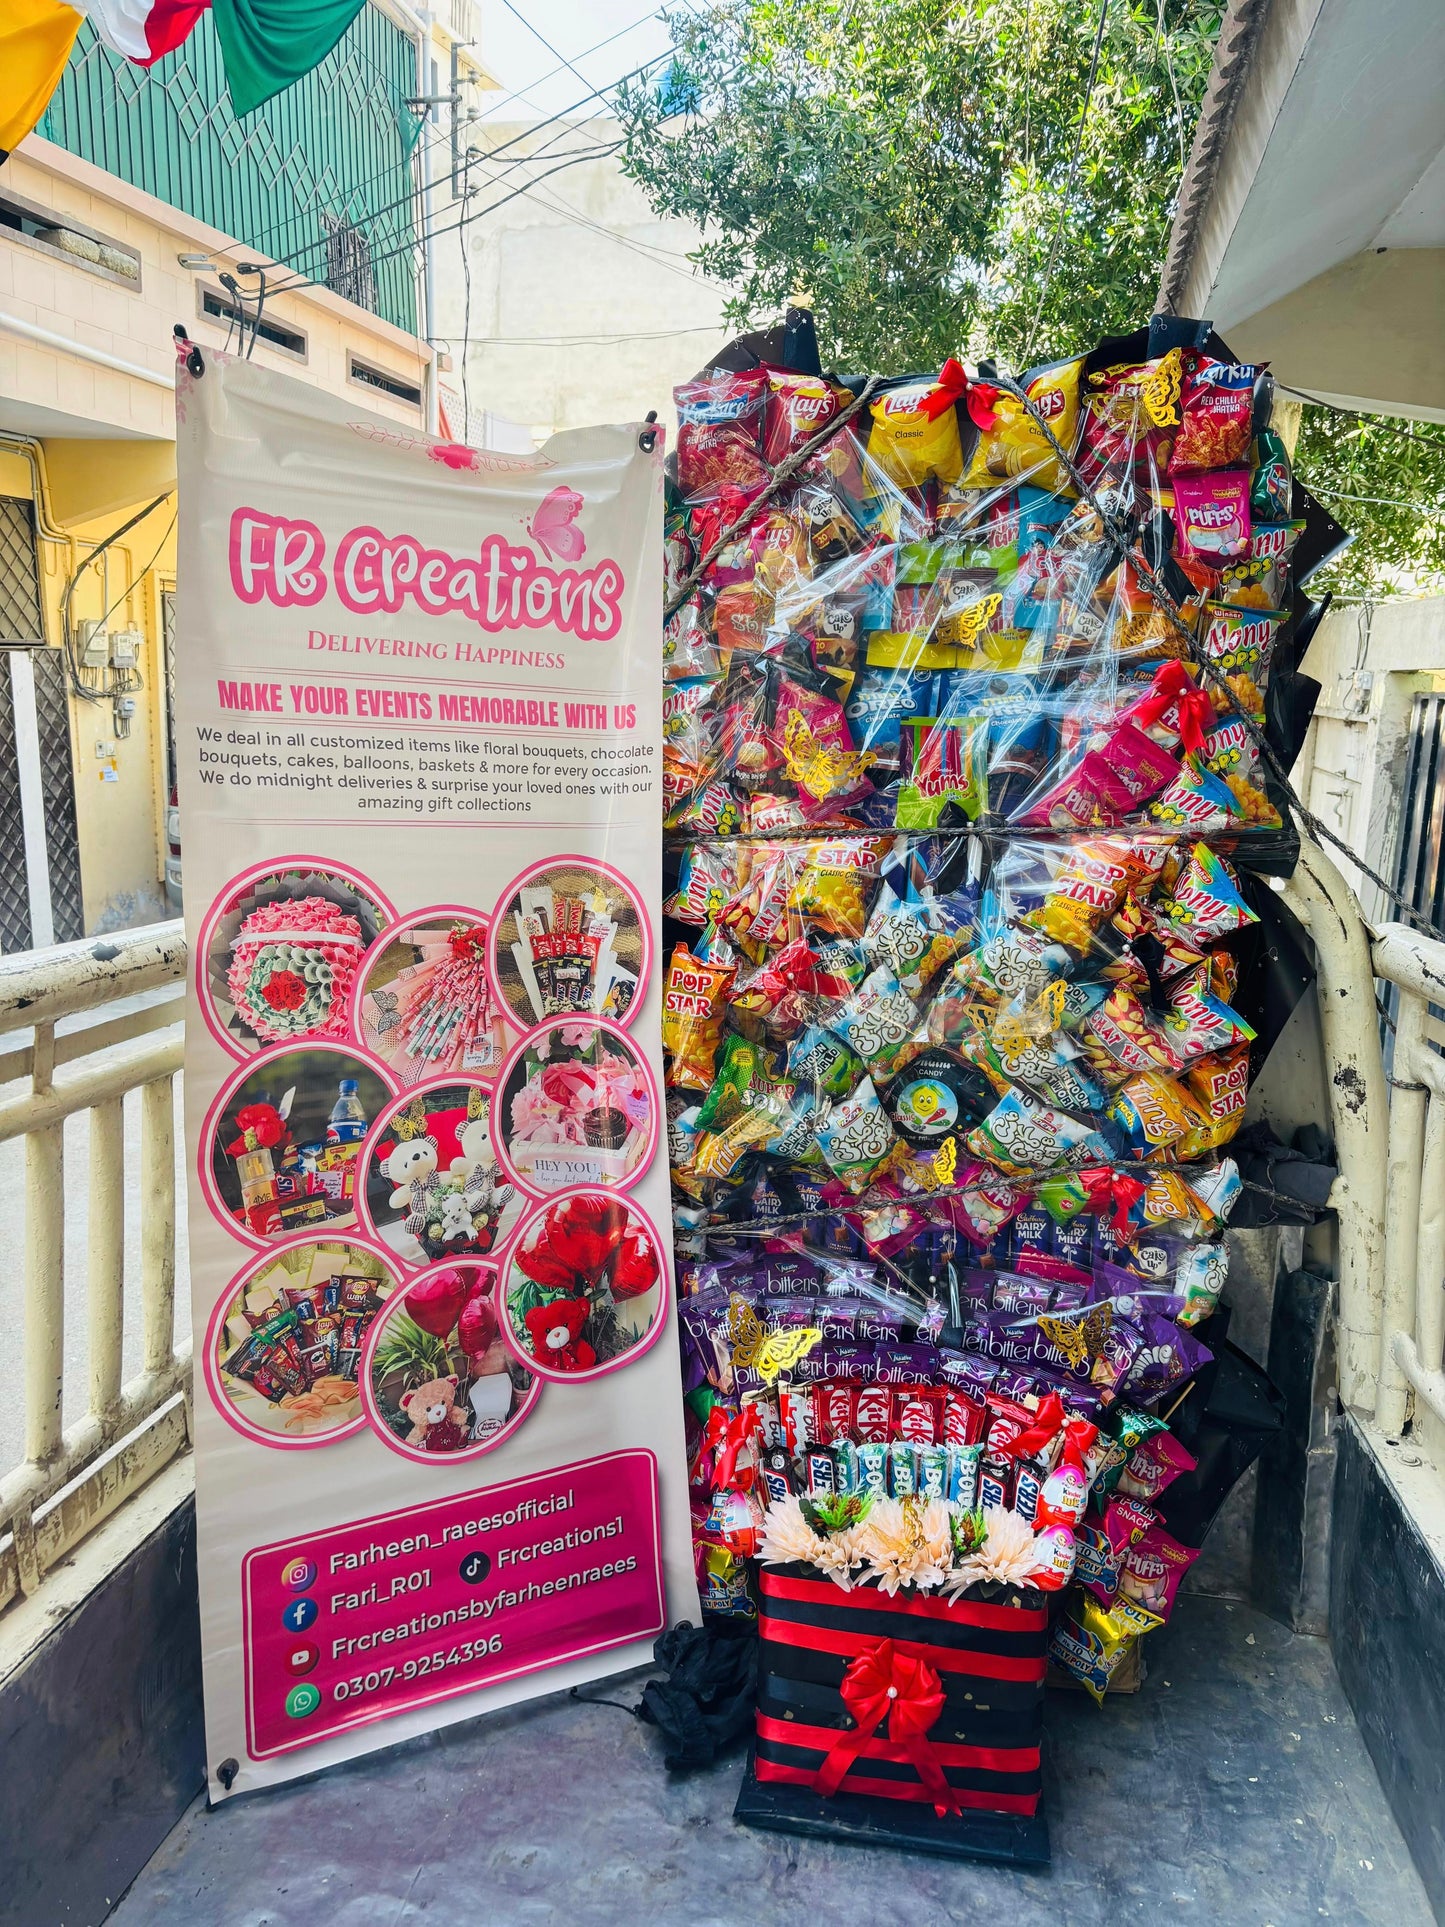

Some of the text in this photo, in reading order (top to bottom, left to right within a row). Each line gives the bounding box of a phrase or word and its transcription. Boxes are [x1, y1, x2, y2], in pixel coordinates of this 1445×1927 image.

[788, 389, 832, 420] Lay's
[1201, 395, 1237, 406] RED CHILLI
[895, 428, 924, 439] Classic
[1188, 506, 1235, 527] PUFFS
[230, 508, 622, 638] FR Creations
[1223, 557, 1274, 585] POPS
[1213, 609, 1243, 619] Winner
[1206, 620, 1271, 656] Nony
[217, 680, 636, 730] MAKE YOUR EVENTS MEMORABLE WITH US
[197, 727, 654, 761] We deal in all customized items like floral bouquets, chocolate
[1205, 722, 1246, 757] ony
[199, 748, 652, 779] bouquets, cakes, balloons, baskets & more for every occasion.
[1181, 761, 1203, 785] Winner
[1207, 748, 1242, 774] OPS
[199, 769, 653, 796] We do midnight deliveries & surprise your loved ones with our
[913, 774, 970, 798] Yums
[358, 796, 532, 813] amazing gift collections
[817, 849, 878, 869] STAR
[1067, 853, 1127, 884] POP
[1190, 859, 1213, 885] Winner
[678, 866, 718, 925] Nony
[1055, 876, 1118, 911] STAR
[1172, 872, 1229, 922] Nony
[752, 909, 779, 941] CHAT
[671, 968, 713, 994] POP
[666, 992, 713, 1019] STAR
[1166, 976, 1226, 1032] Nony
[1091, 1009, 1122, 1047] CHAT
[919, 1068, 944, 1078] CANDY
[1211, 1060, 1249, 1097] POP
[742, 1088, 782, 1115] SOU
[535, 1159, 560, 1172] HEY
[756, 1205, 780, 1215] MILK
[1016, 1212, 1046, 1224] Cadbury
[1015, 1222, 1047, 1233] DAIRY
[1018, 1230, 1042, 1240] MILK
[1058, 1235, 1083, 1245] MILK
[1140, 1249, 1166, 1262] Cake
[857, 1387, 890, 1444] KitKa
[1126, 1435, 1136, 1446] 10
[1063, 1487, 1082, 1499] Kinder
[1116, 1506, 1151, 1531] SNACK
[1120, 1497, 1160, 1523] POLY
[329, 1490, 574, 1574] Farheen_raeesofficial
[497, 1516, 624, 1569] Frcreations1
[1132, 1532, 1142, 1544] 10
[1053, 1547, 1072, 1560] Kinder
[1126, 1553, 1170, 1577] PUFFS
[331, 1569, 432, 1614] Fari_R01
[332, 1555, 637, 1659] Frcreationsbyfarheenraees
[1115, 1597, 1159, 1628] POLY
[1110, 1610, 1144, 1636] SNACK
[1070, 1642, 1085, 1657] 10
[333, 1634, 502, 1701] 0307-9254396
